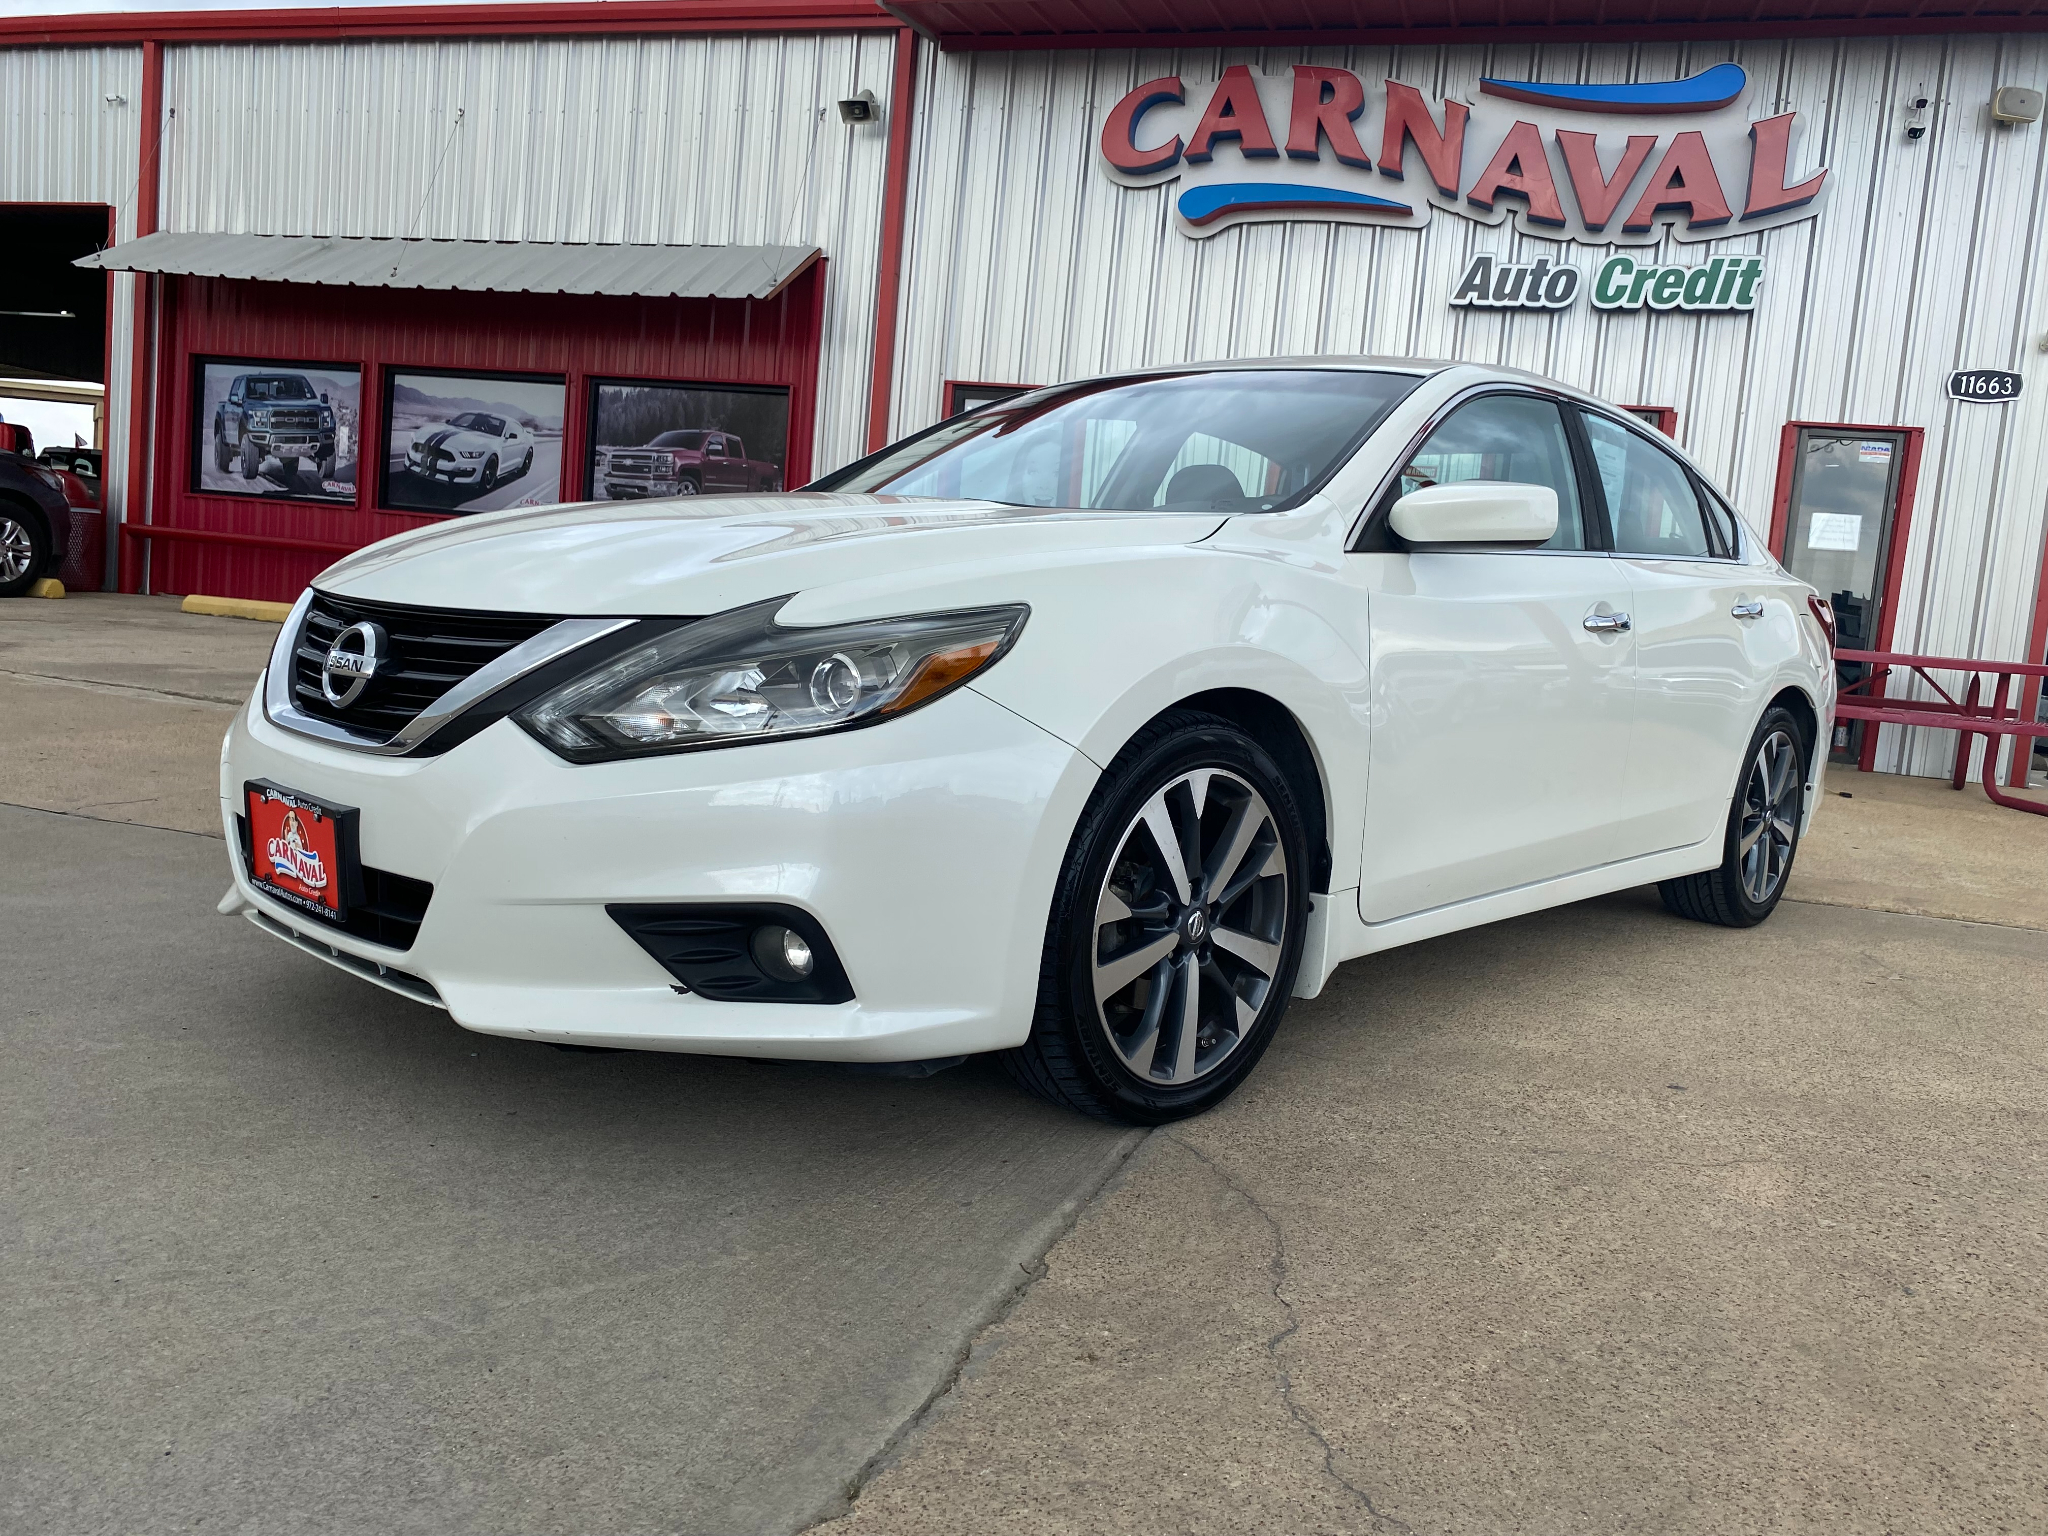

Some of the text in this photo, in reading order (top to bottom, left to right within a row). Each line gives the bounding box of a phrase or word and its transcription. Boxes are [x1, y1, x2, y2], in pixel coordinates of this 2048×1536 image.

[1100, 63, 1831, 235] CARNAVAL
[1453, 255, 1765, 306] Auto Credit
[1960, 375, 2013, 395] 11663
[266, 788, 297, 808] CARNAVAL
[268, 838, 326, 883] CARNAVAL
[298, 883, 309, 893] Auto
